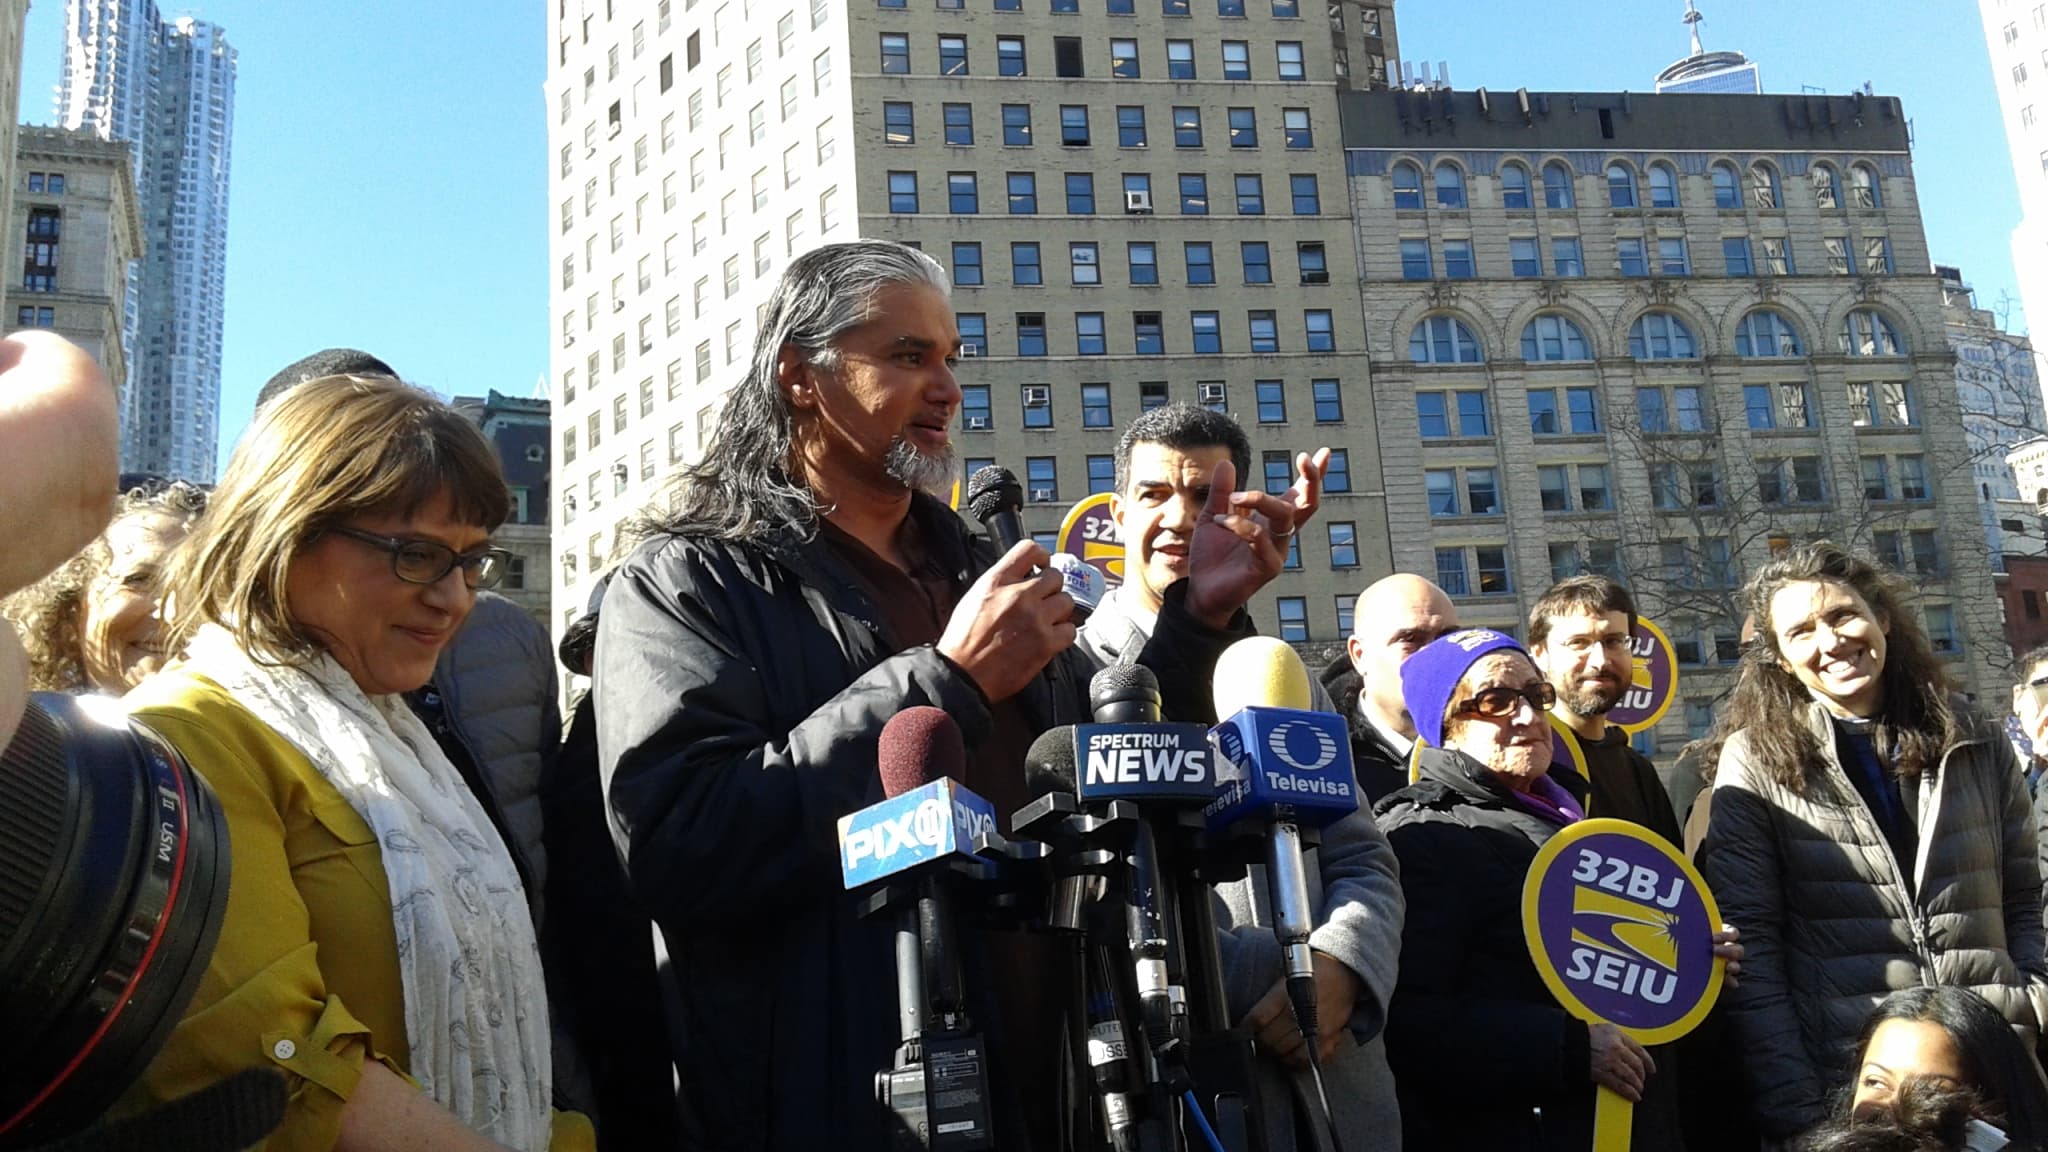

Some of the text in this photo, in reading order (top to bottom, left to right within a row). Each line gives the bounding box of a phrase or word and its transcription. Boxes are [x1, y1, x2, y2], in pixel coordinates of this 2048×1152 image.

[1082, 516, 1125, 543] 32
[1615, 690, 1653, 709] IU
[1089, 733, 1180, 750] SPECTRUM
[1086, 749, 1206, 785] NEWS
[1266, 771, 1350, 796] Televisa
[1202, 779, 1252, 817] elevisa
[158, 822, 176, 862] USM
[1572, 849, 1685, 909] 32BJ
[1567, 948, 1679, 1004] SEIU
